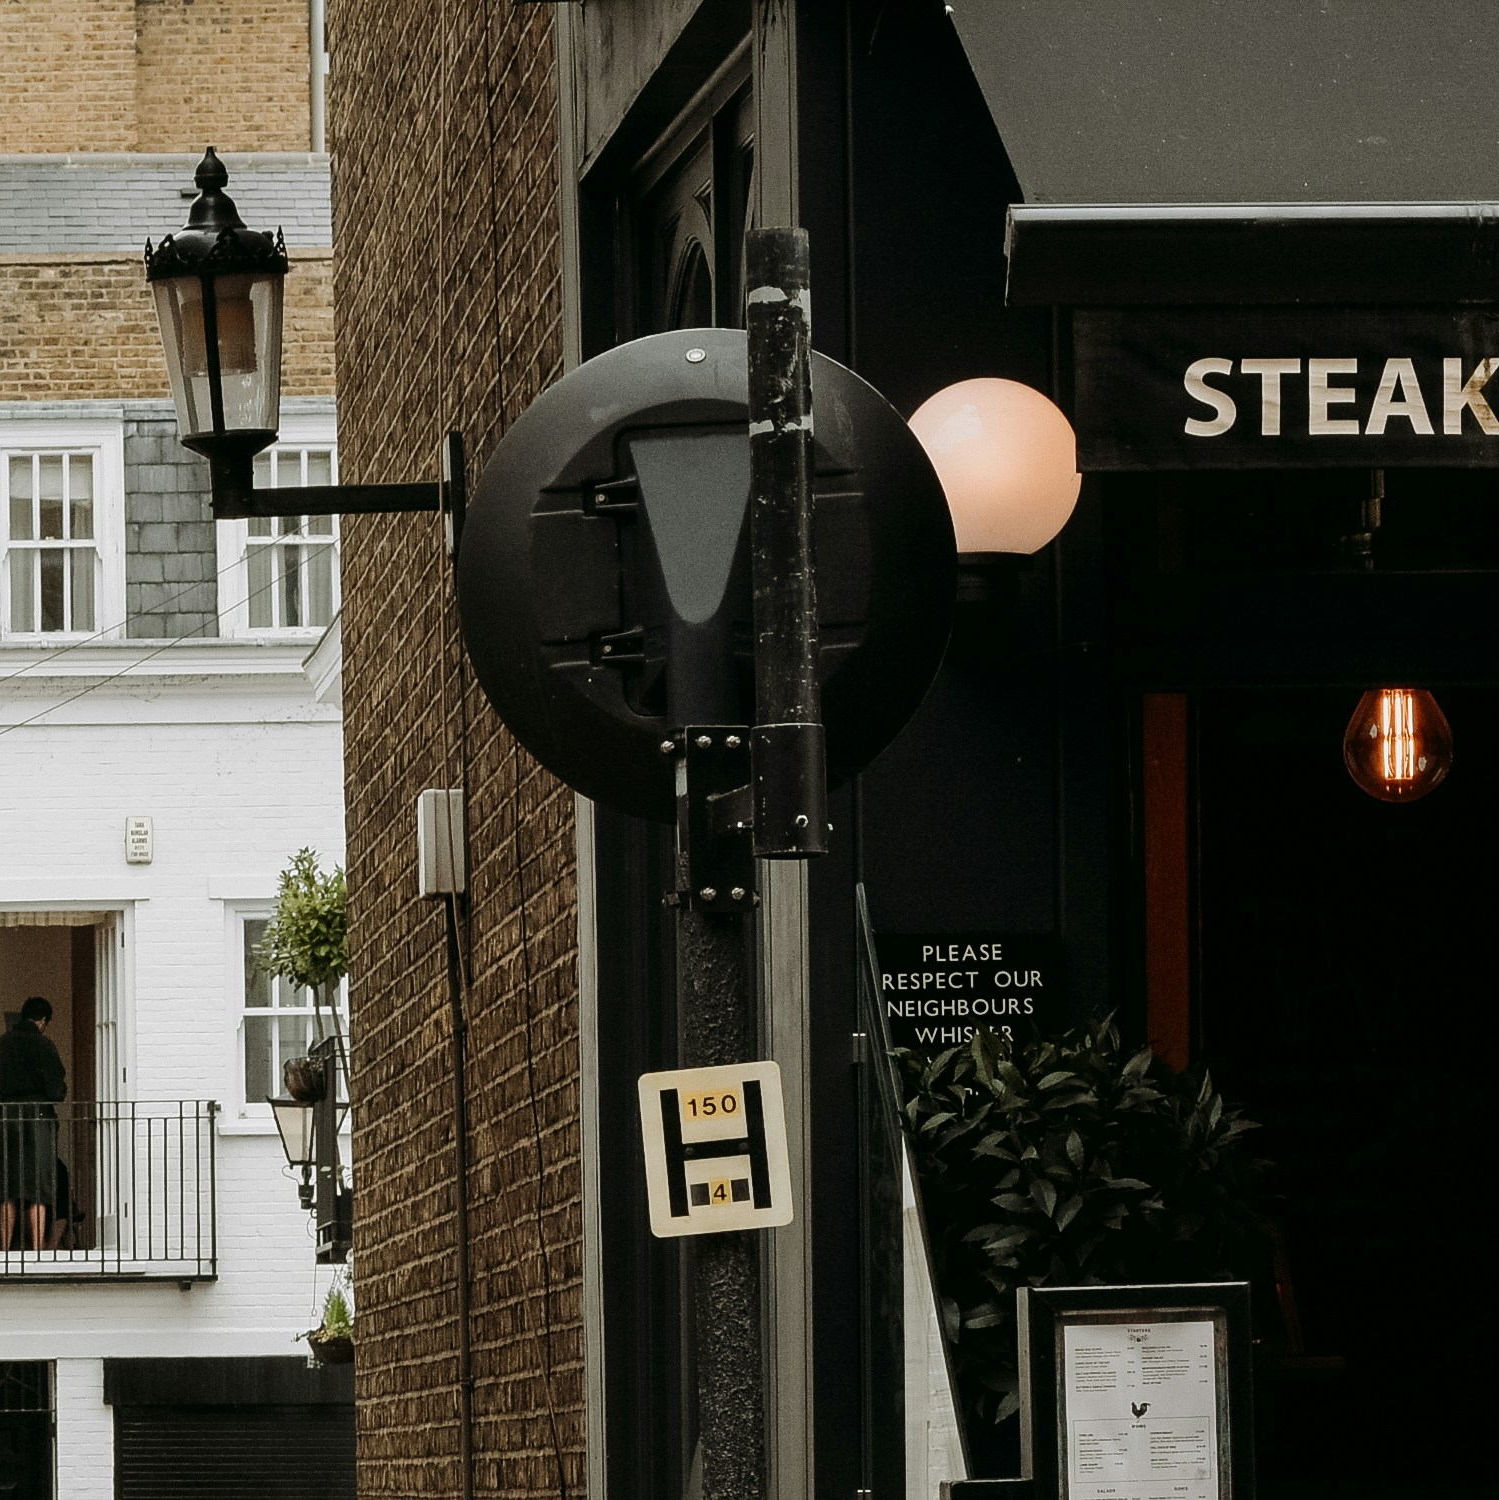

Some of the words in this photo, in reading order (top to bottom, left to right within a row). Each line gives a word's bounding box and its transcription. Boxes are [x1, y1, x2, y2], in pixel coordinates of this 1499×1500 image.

[1184, 357, 1499, 437] STEAK
[922, 943, 1003, 963] PLEASE
[881, 971, 979, 991] RESPECT
[993, 970, 1043, 988] OUR
[887, 997, 1034, 1018] NEIGHBOURS
[914, 1025, 1014, 1045] WHISR
[687, 1094, 737, 1117] 150
[713, 1183, 727, 1201] 4
